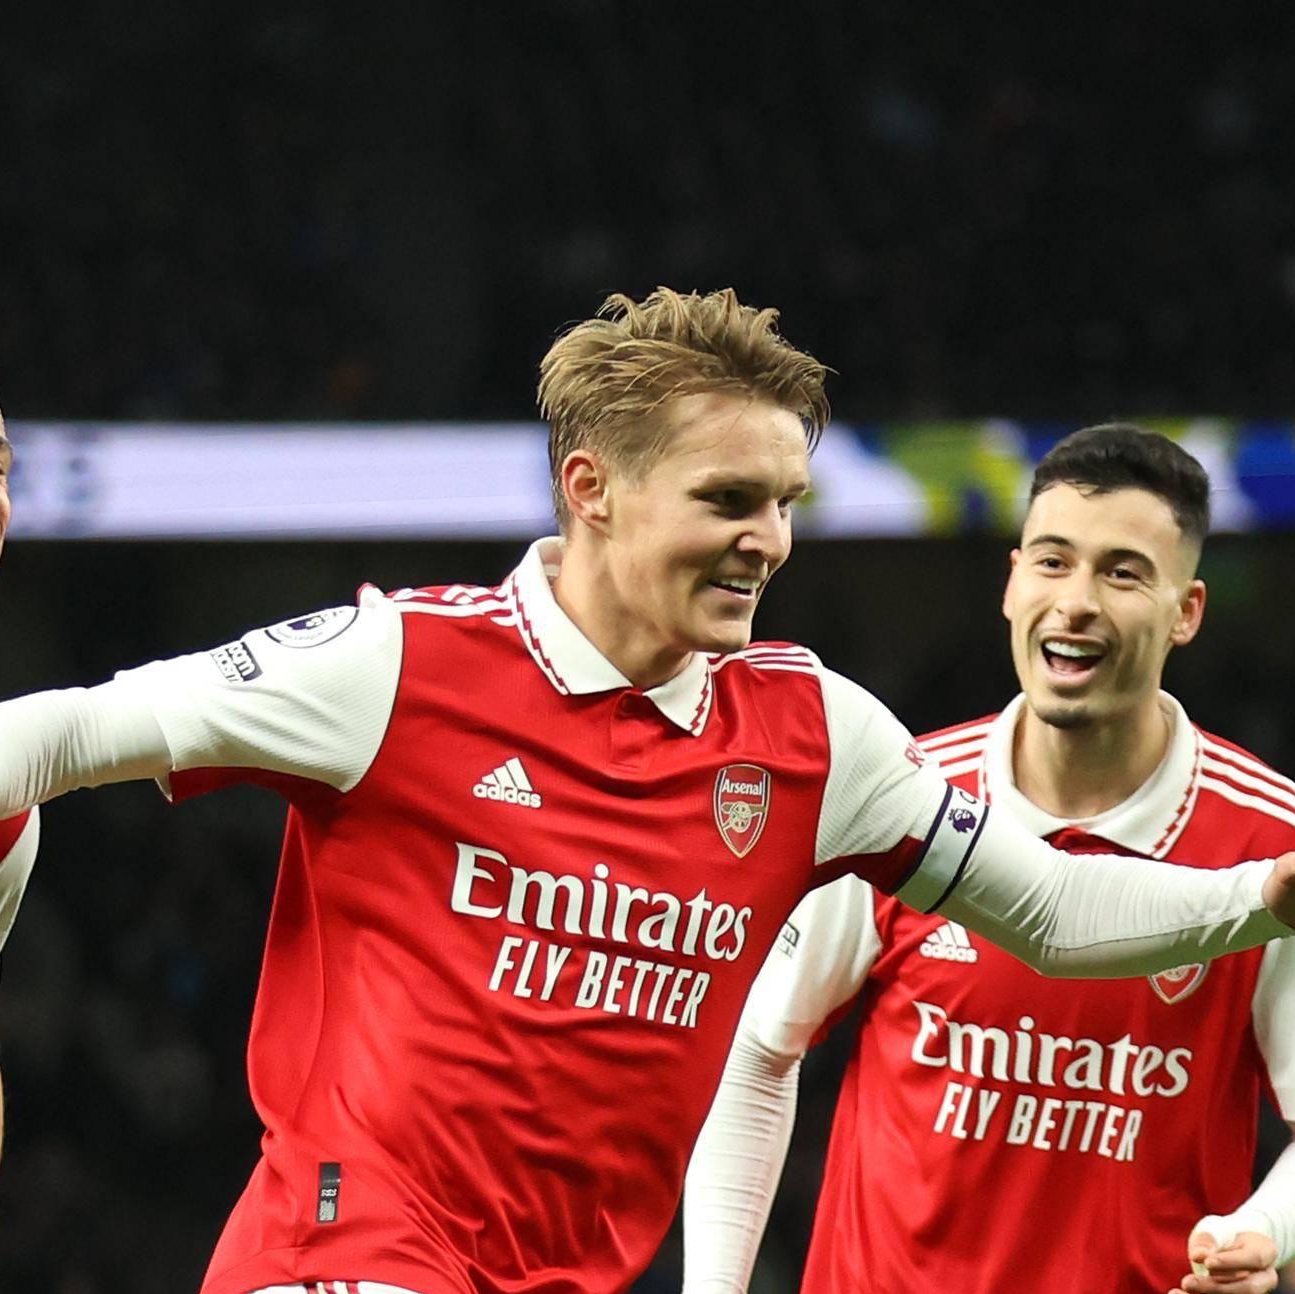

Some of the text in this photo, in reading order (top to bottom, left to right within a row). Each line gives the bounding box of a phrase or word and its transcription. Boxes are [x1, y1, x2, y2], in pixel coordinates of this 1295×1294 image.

[472, 781, 542, 809] adidas
[721, 778, 763, 796] Arsenal
[451, 841, 753, 962] Emirates
[488, 935, 711, 1029] FLY BETTER
[919, 942, 978, 963] adidas
[910, 1000, 1194, 1098] Emirates
[933, 1081, 1143, 1162] FLY BETTER
